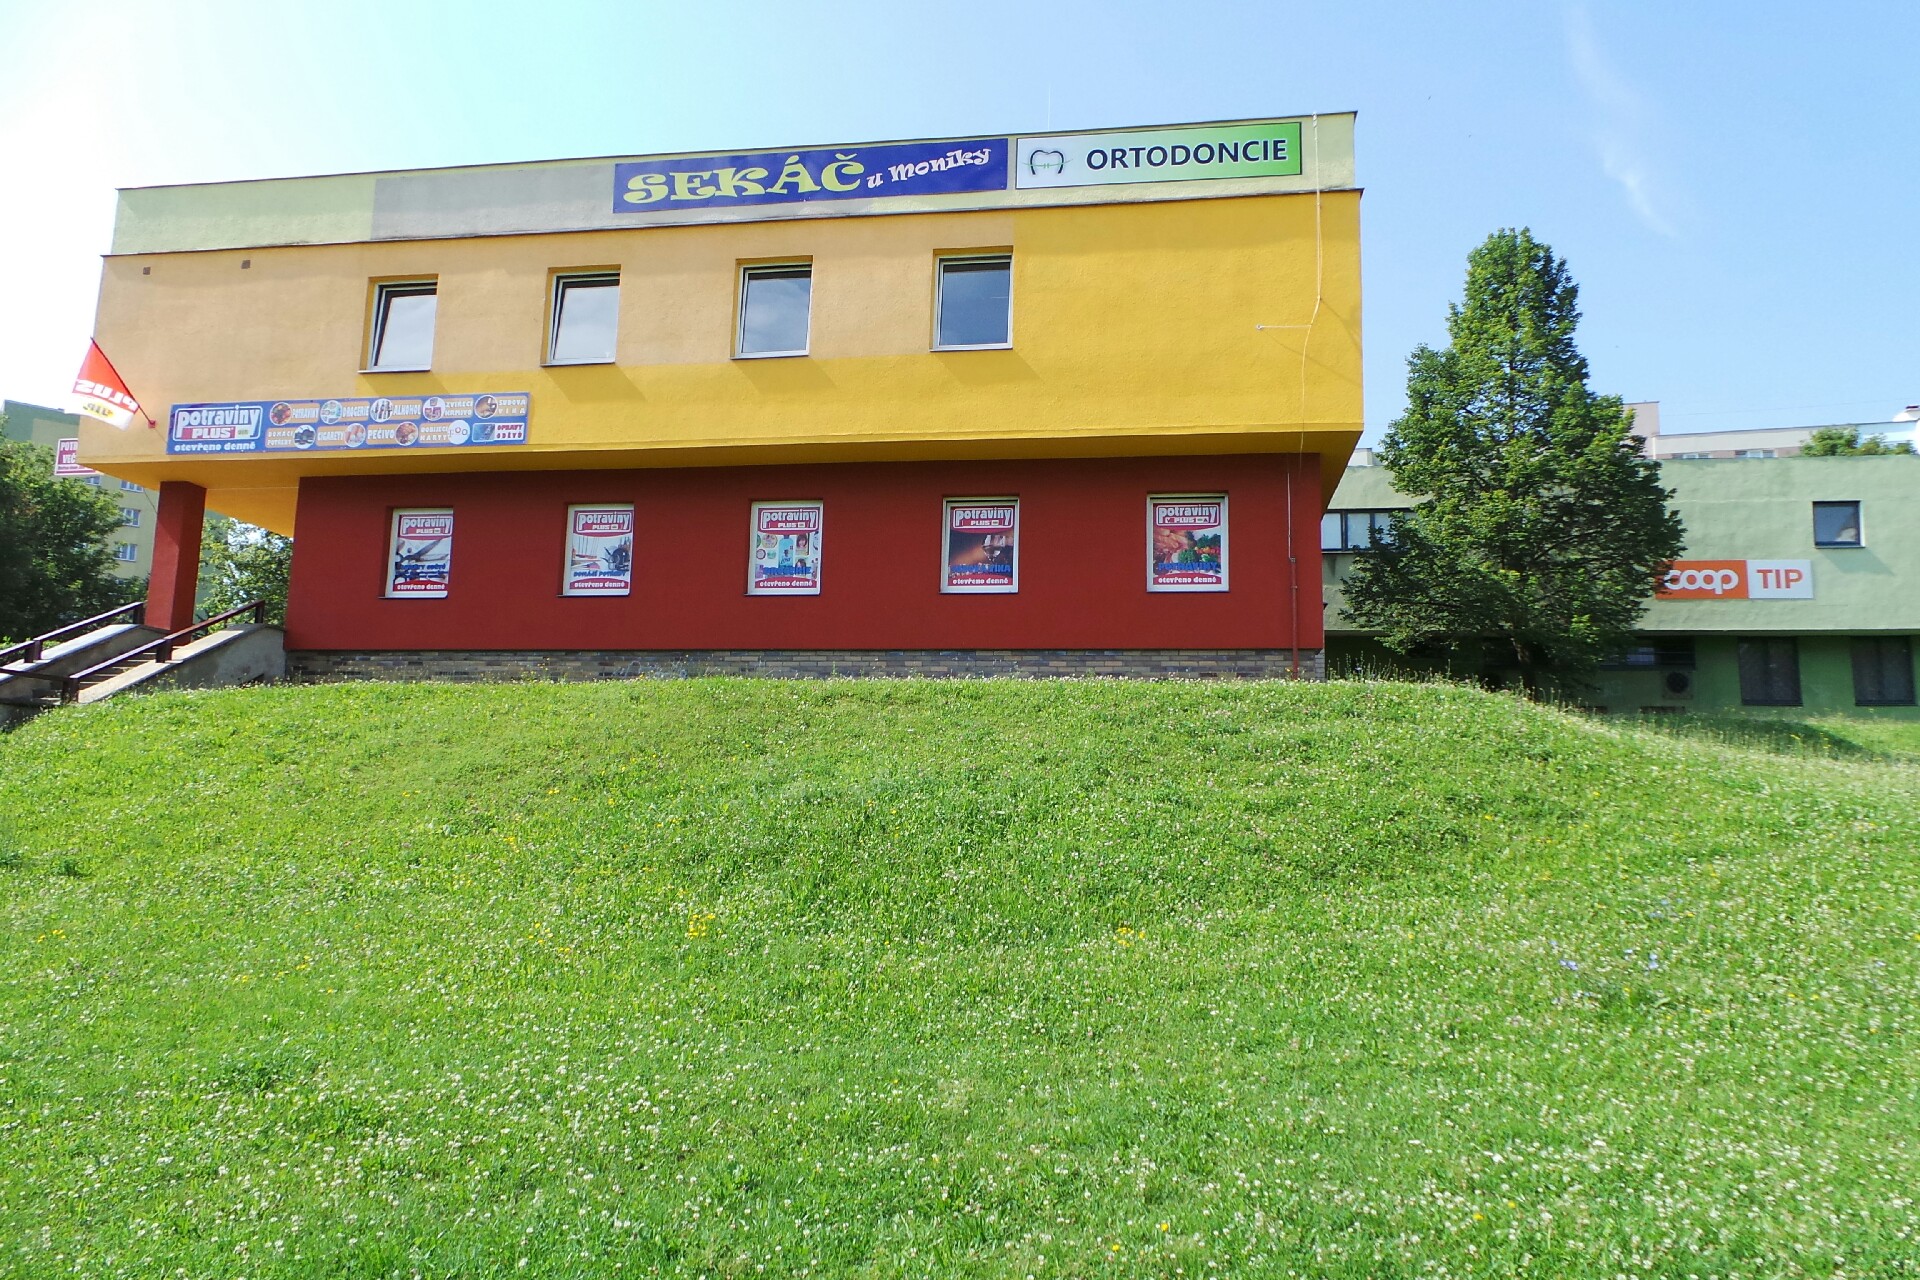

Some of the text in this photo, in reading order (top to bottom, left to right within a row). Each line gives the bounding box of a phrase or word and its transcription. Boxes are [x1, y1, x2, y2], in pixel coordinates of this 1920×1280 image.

[1086, 139, 1288, 170] ORTODONCIE
[623, 153, 865, 204] SEKÁČ
[866, 173, 884, 189] u
[342, 405, 370, 418] DROGERIE
[393, 404, 422, 416] ALKOHOL
[176, 405, 260, 438] potraviny
[191, 427, 232, 439] PLUS
[368, 428, 395, 441] PEČIVO
[174, 442, 255, 451] otevřeno denně
[578, 511, 629, 530] potraviny
[763, 509, 816, 529] potraviny
[955, 507, 1011, 526] potraviny
[1158, 504, 1217, 524] potraviny
[403, 516, 451, 534] potraviny
[1664, 568, 1804, 595] coop TIP
